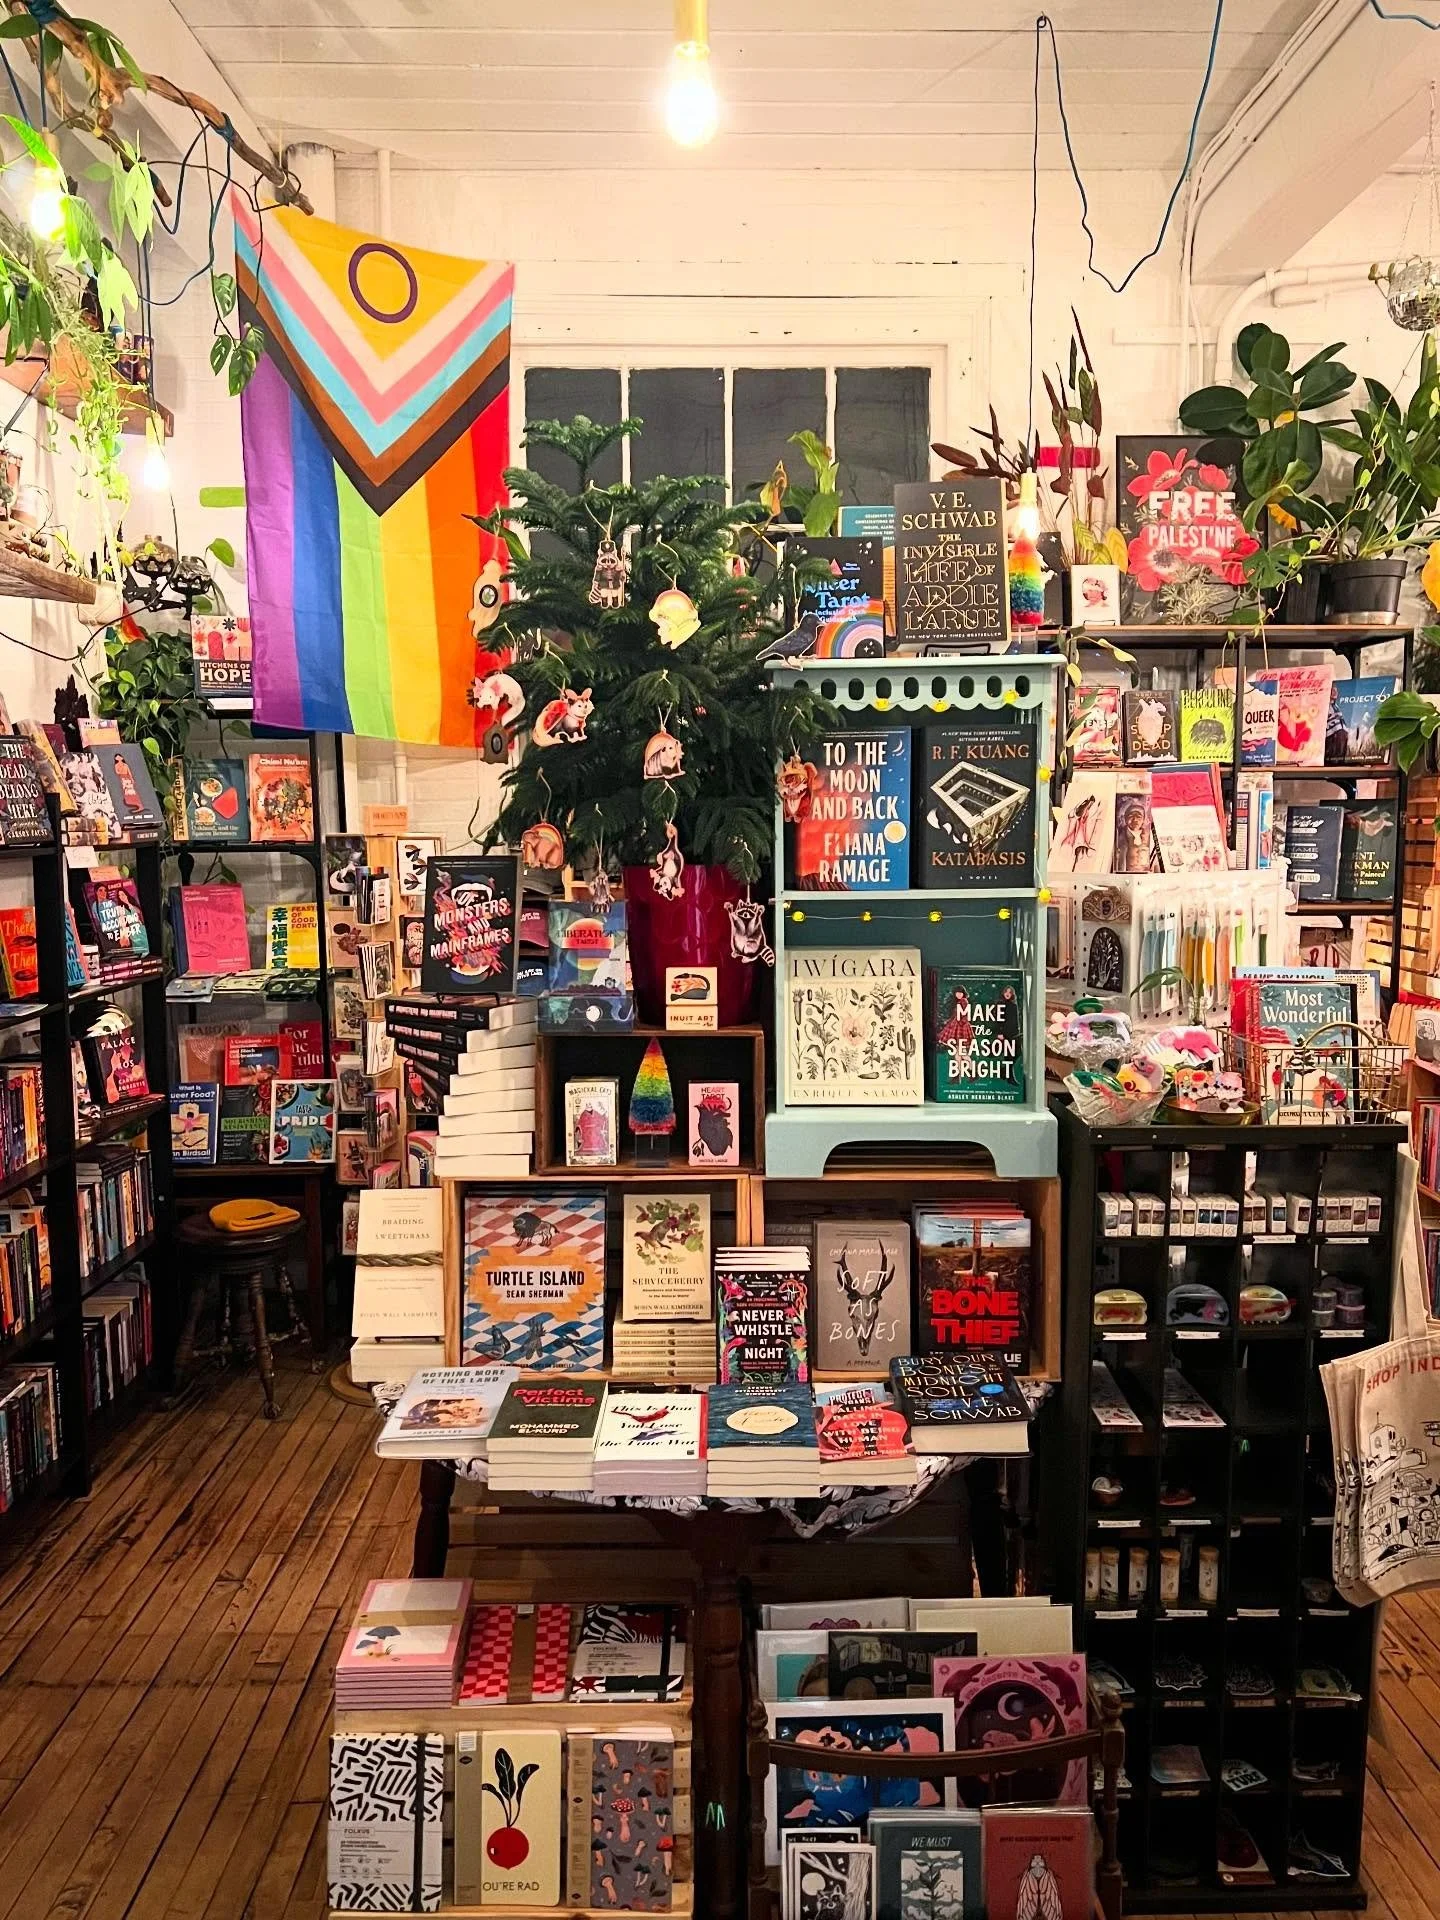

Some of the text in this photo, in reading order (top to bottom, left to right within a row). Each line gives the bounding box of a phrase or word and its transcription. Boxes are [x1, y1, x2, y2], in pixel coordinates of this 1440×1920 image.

[930, 491, 972, 509] V. E.
[1148, 490, 1237, 523] FREE
[902, 511, 997, 531] SCHWAB
[938, 534, 962, 542] THE
[1148, 525, 1237, 548] PALESTINE
[903, 543, 998, 559] INVISIBLE
[904, 561, 996, 584] LIFE OF
[814, 592, 871, 609] Tarot
[902, 584, 999, 608] ADDIE
[904, 608, 1001, 631] LARUE
[200, 669, 252, 682] HOPE
[1339, 694, 1376, 703] PROJECT
[1245, 710, 1275, 724] QUEER
[3, 744, 26, 759] THE
[932, 744, 1030, 760] R. F. KUANG
[1132, 739, 1171, 751] DEAD
[823, 741, 888, 766] TO THE
[0, 763, 27, 779] DEAD
[829, 769, 881, 793] MOON
[0, 784, 39, 799] BELONG
[811, 795, 899, 820] AND BACK
[931, 851, 1026, 866] KATABASIS
[1355, 861, 1390, 870] KMAN
[818, 859, 891, 883] RAMAGE
[457, 890, 478, 906] OF
[101, 905, 126, 920] TRUTH
[433, 897, 508, 928] MONSTERS
[466, 918, 491, 935] AND
[107, 932, 114, 940] TO
[430, 926, 511, 958] MAINFRAMES
[10, 953, 38, 969] Ther
[793, 954, 917, 977] IWÍGARA
[1285, 989, 1324, 1007] Most
[956, 1004, 1006, 1022] MAKE
[1263, 1005, 1347, 1024] Wonderful
[973, 1024, 993, 1036] the
[101, 1035, 136, 1049] PALACE
[947, 1038, 1016, 1057] SEASON
[949, 1060, 1014, 1079] BRIGHT
[568, 1086, 598, 1095] MAGICKAL
[281, 1115, 327, 1126] PRIDE
[485, 1271, 585, 1286] TURTLE ISLAND
[658, 1267, 679, 1275] THE
[632, 1277, 705, 1285] SERVICEBERRY
[837, 1270, 888, 1293] SOFT
[965, 1276, 991, 1287] THE
[506, 1289, 565, 1298] SEAN SHERMAN
[849, 1298, 876, 1317] AS
[931, 1289, 1020, 1316] BONE
[742, 1309, 784, 1322] NEVER
[734, 1324, 793, 1336] WHISTLE
[829, 1319, 900, 1343] BONES
[930, 1318, 1020, 1345] THIEF
[744, 1347, 784, 1359] NIGHT
[898, 1353, 996, 1366] BURY OUR
[900, 1363, 986, 1377] BONES
[904, 1372, 1003, 1387] MIDNIGHT
[1366, 1364, 1400, 1394] SHOP
[513, 1388, 584, 1396] Perfect
[907, 1386, 974, 1398] SOIL
[522, 1396, 596, 1404] Victims
[962, 1396, 1000, 1408] V. E.
[914, 1406, 1022, 1420] SCHWAB
[823, 1429, 857, 1437] WITH
[839, 1435, 888, 1443] HUMAN
[911, 1836, 952, 1848] WE MUST
[482, 1880, 540, 1892] OU'RE RAD
